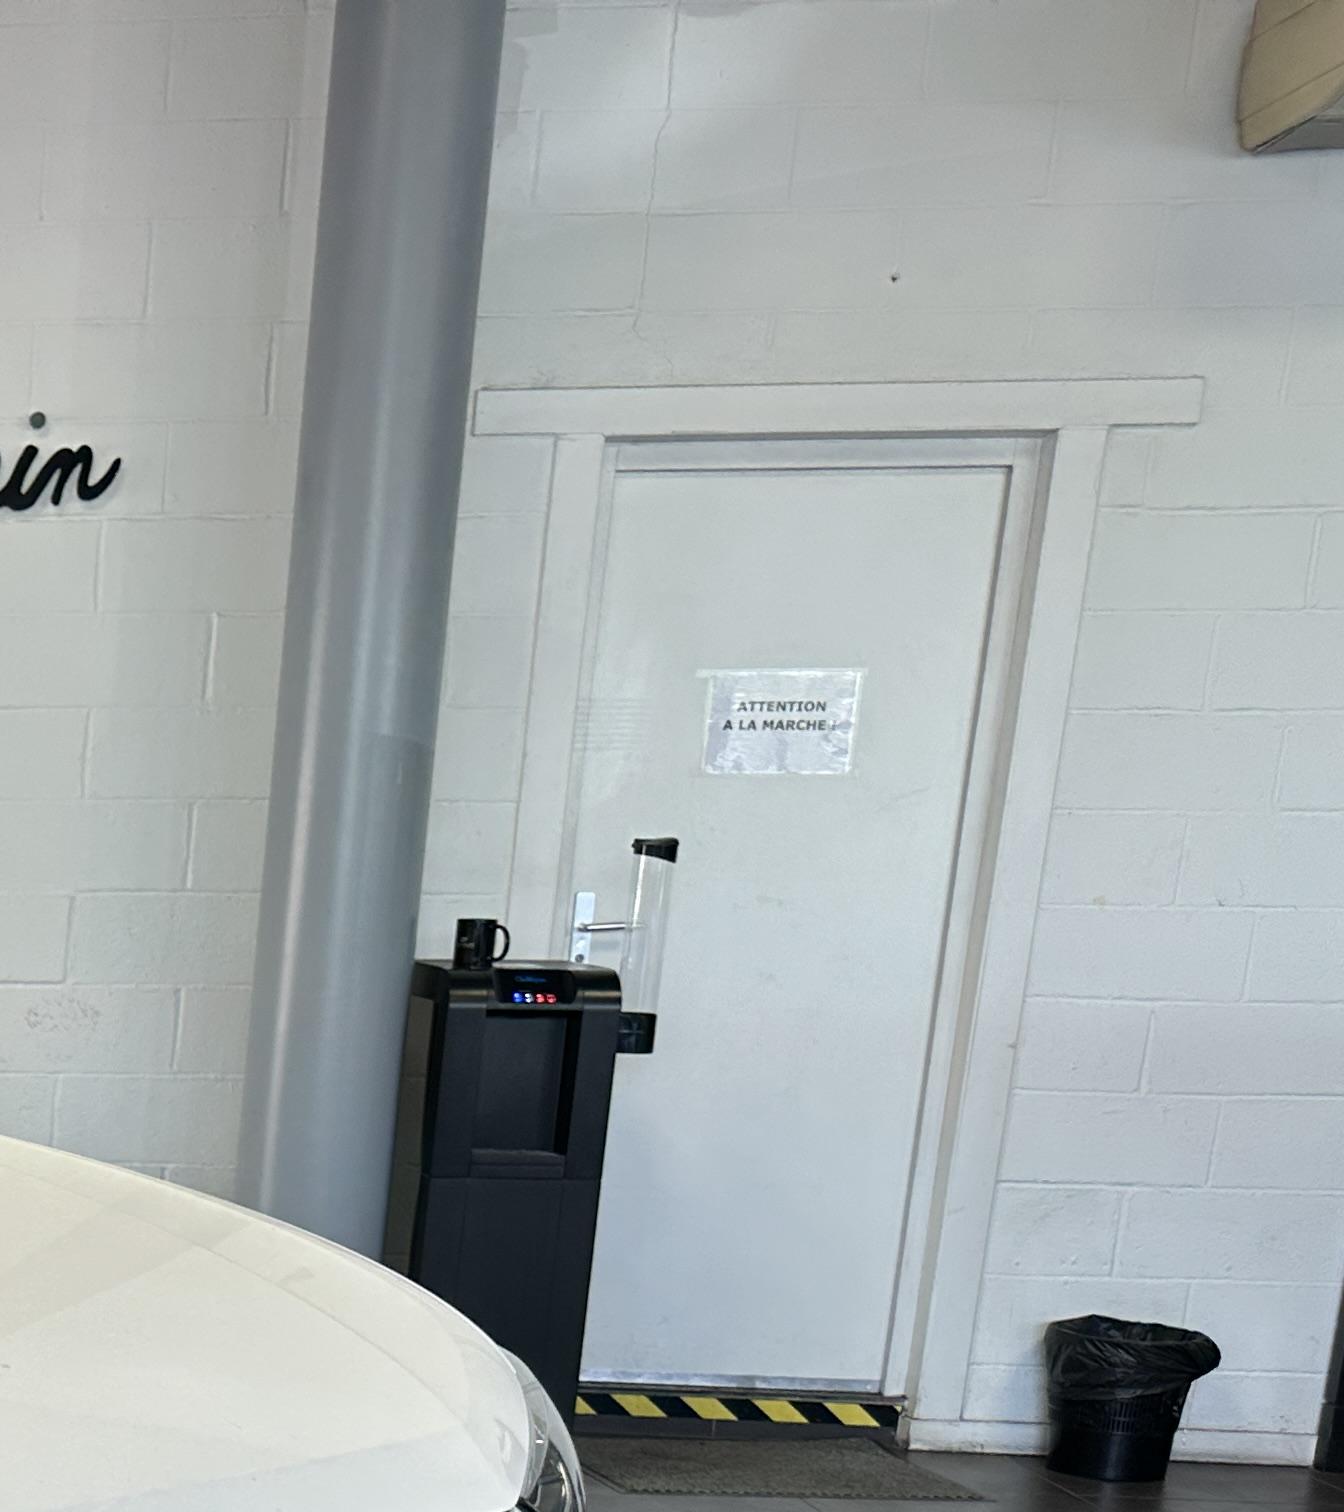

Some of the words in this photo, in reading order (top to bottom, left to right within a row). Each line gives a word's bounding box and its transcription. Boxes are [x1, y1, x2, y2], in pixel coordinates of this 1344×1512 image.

[736, 700, 827, 713] ATTENTION
[722, 719, 733, 731] A
[738, 719, 757, 731] LA
[761, 719, 827, 731] MARCHE
